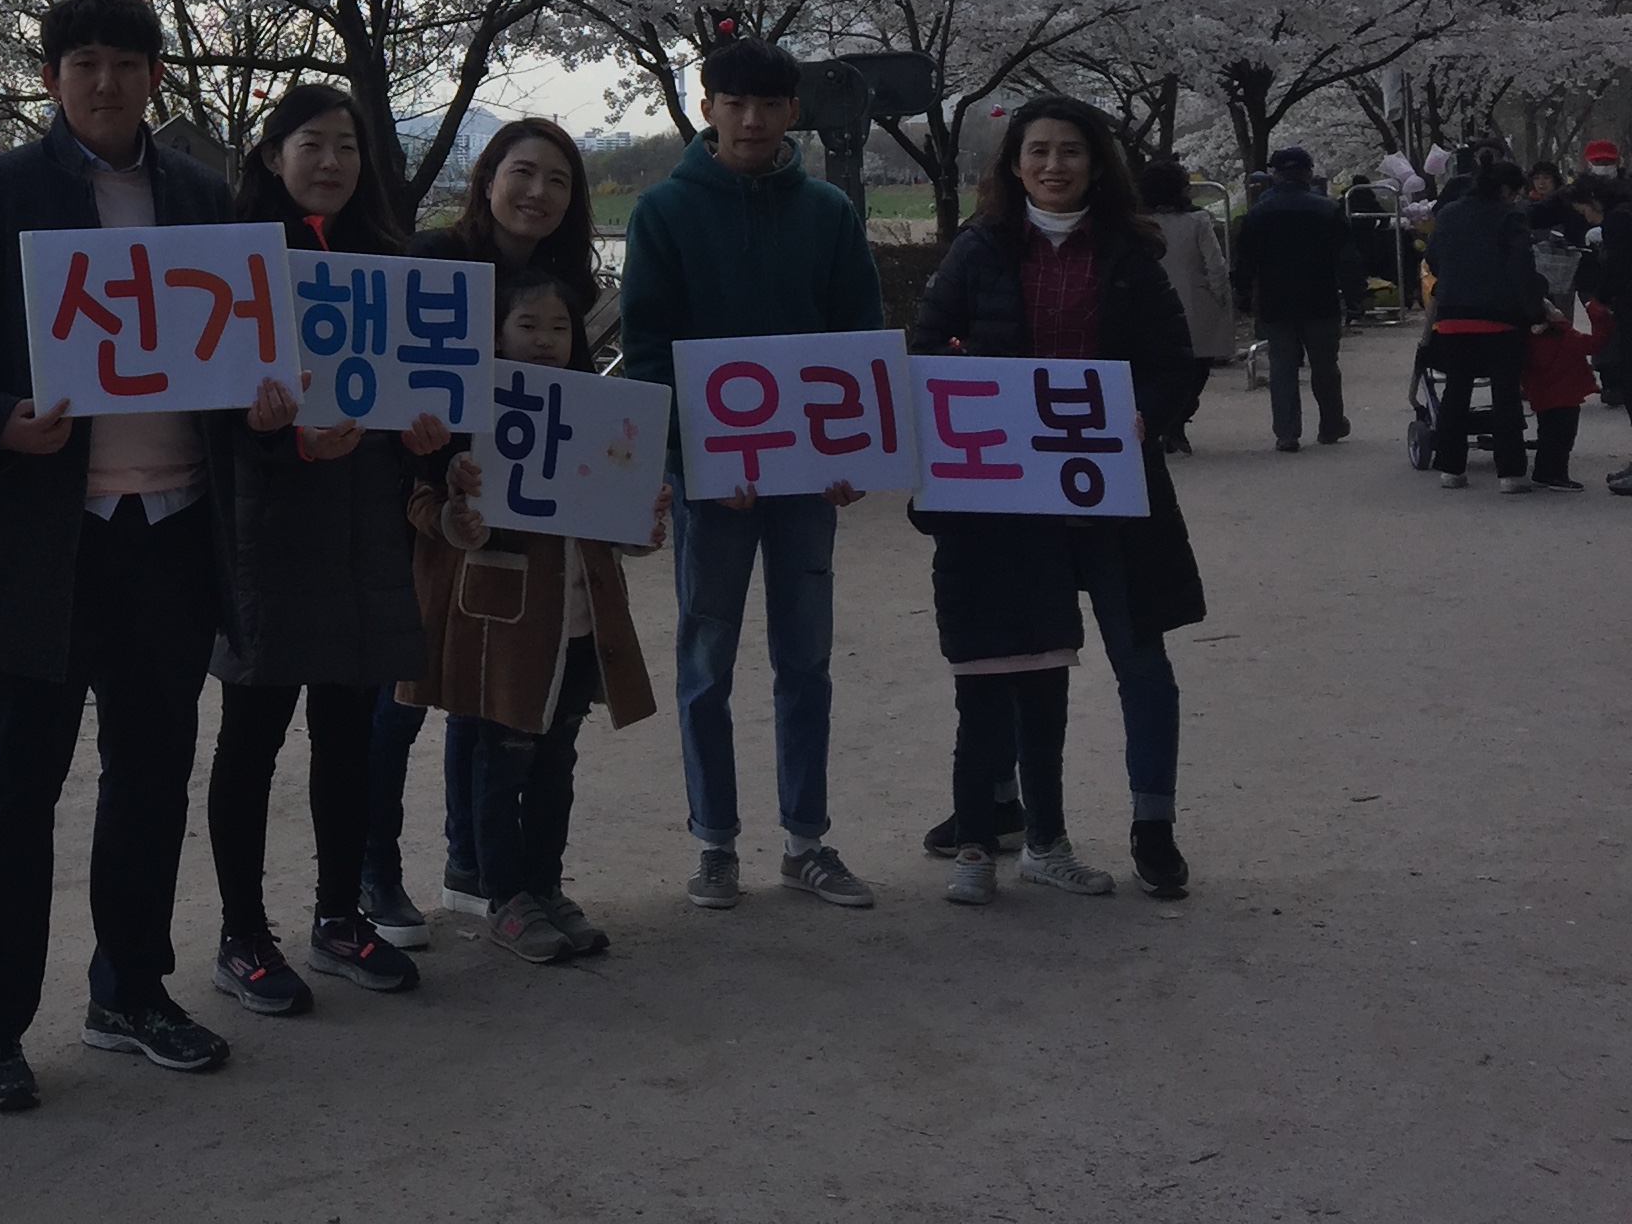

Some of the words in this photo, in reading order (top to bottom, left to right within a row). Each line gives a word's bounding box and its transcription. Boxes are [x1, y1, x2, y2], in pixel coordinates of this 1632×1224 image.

[51, 244, 276, 397] 선거
[296, 260, 481, 425] 행복
[494, 370, 573, 518] 한
[704, 358, 898, 482] 우리
[925, 367, 1124, 508] 도봉
